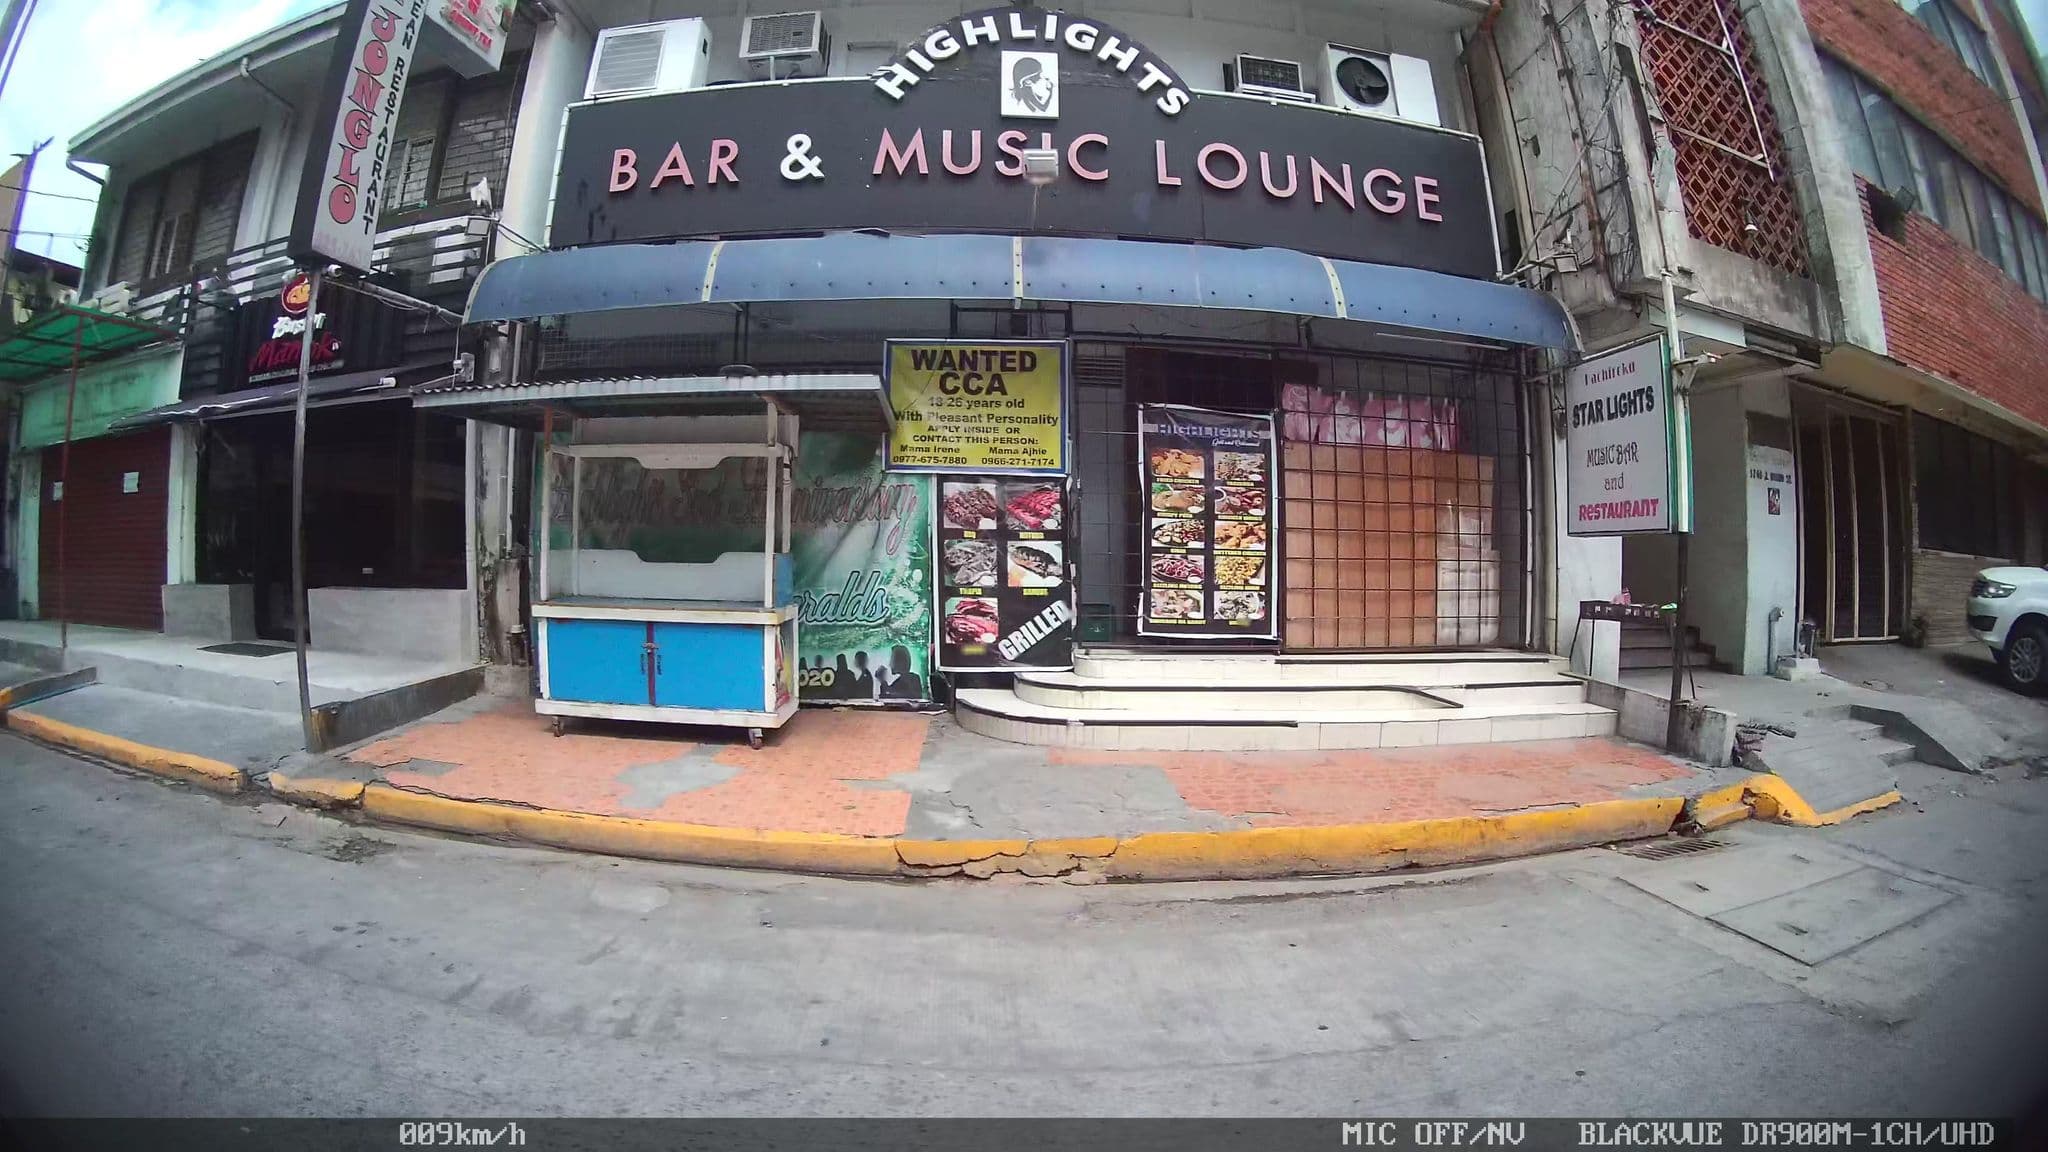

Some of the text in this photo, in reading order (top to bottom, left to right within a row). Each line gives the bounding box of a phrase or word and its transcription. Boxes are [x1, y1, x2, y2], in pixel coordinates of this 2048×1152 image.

[875, 12, 1190, 117] HIGHLIGHTS
[363, 0, 425, 235] EAN RESTAURANT
[609, 139, 739, 193] BAR
[780, 133, 825, 181] &
[1156, 139, 1443, 223] LOUNGE
[911, 349, 1038, 373] WANTED
[938, 372, 1008, 396] CCA
[966, 399, 1002, 410] years
[1006, 398, 1025, 409] old
[1573, 385, 1655, 428] STAR LIGHTS
[895, 410, 1059, 427] With Pleasant Personality
[900, 444, 931, 453] Mama
[934, 445, 961, 454] Irene
[989, 446, 1019, 455] Mama
[912, 434, 1040, 445] CONTACT THIS PERSON:
[1586, 441, 1639, 468] MUSIC BAR
[1604, 471, 1624, 490] and
[998, 599, 1072, 661] GRILLED
